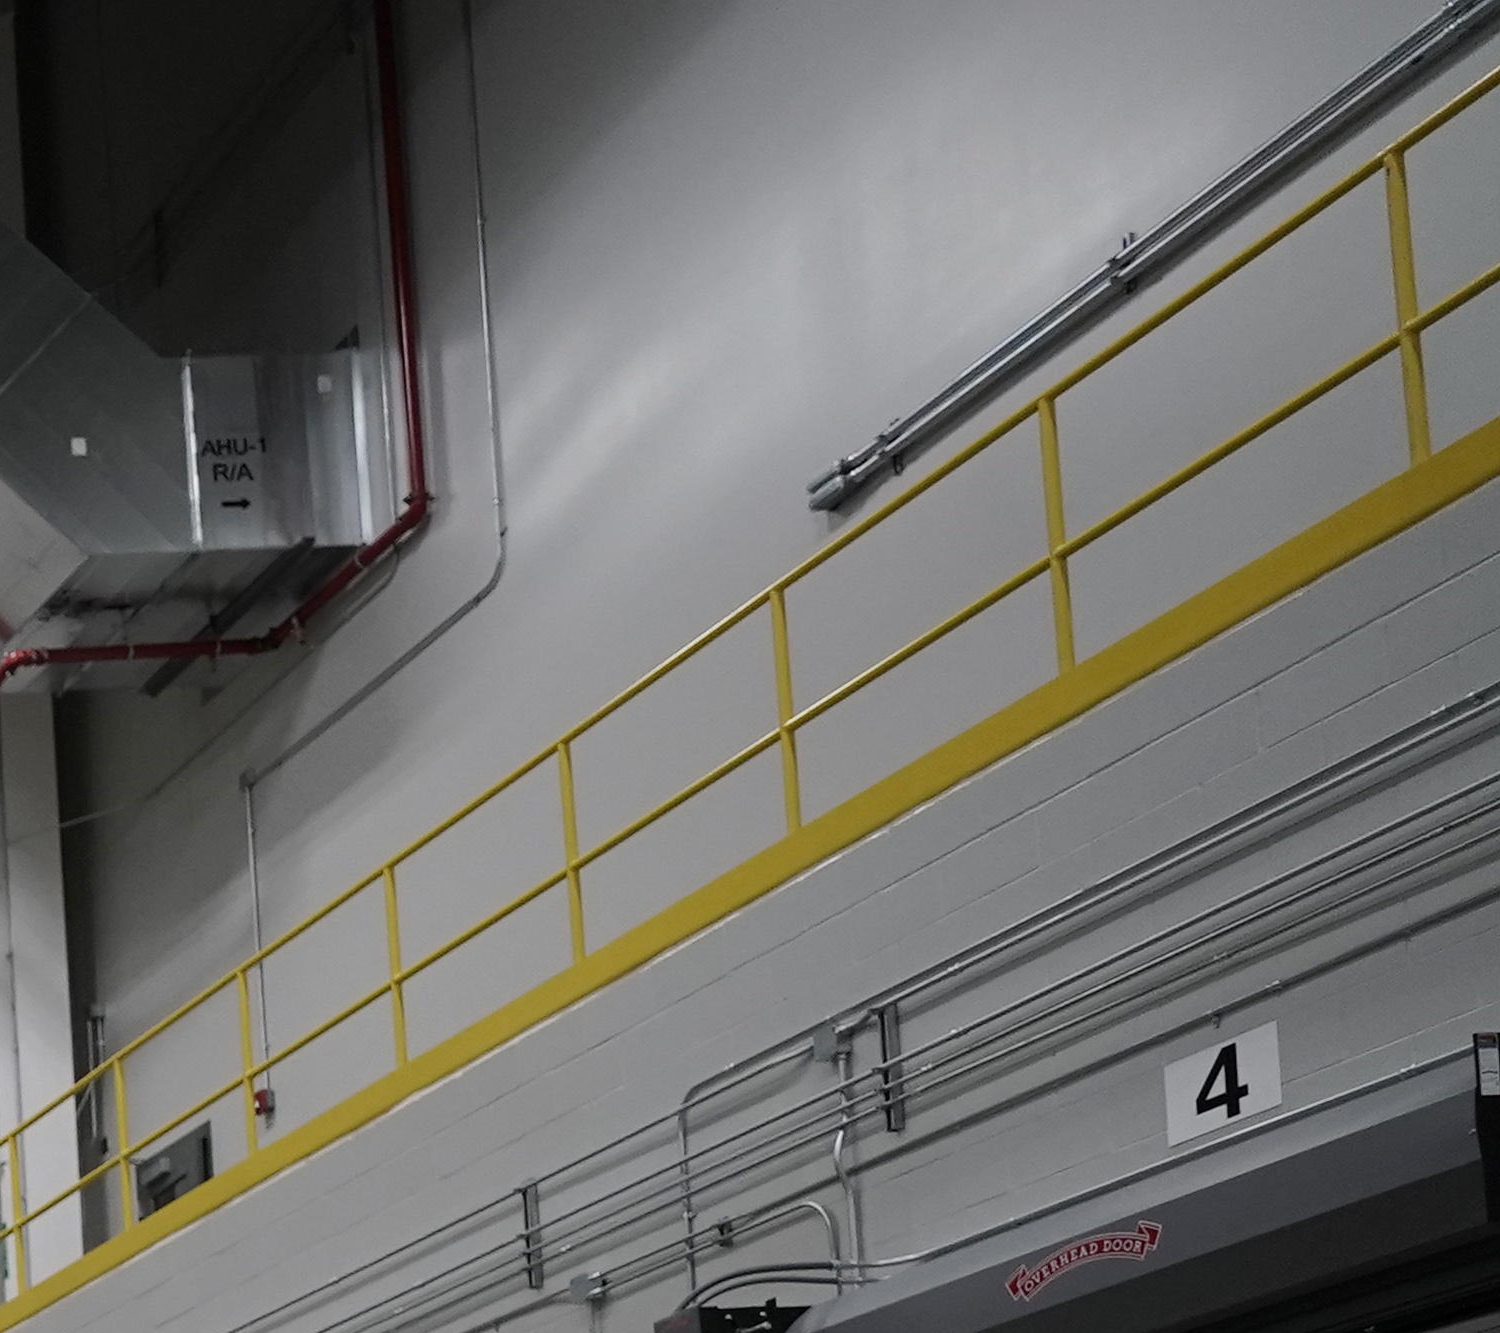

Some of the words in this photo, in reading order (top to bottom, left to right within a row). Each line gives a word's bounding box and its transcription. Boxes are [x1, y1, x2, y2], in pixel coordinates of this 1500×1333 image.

[202, 438, 267, 456] AHU-1
[213, 463, 253, 482] R/A
[1195, 1042, 1248, 1118] 4
[1025, 1242, 1098, 1290] OVERHEAD
[1102, 1239, 1142, 1252] DOOR
